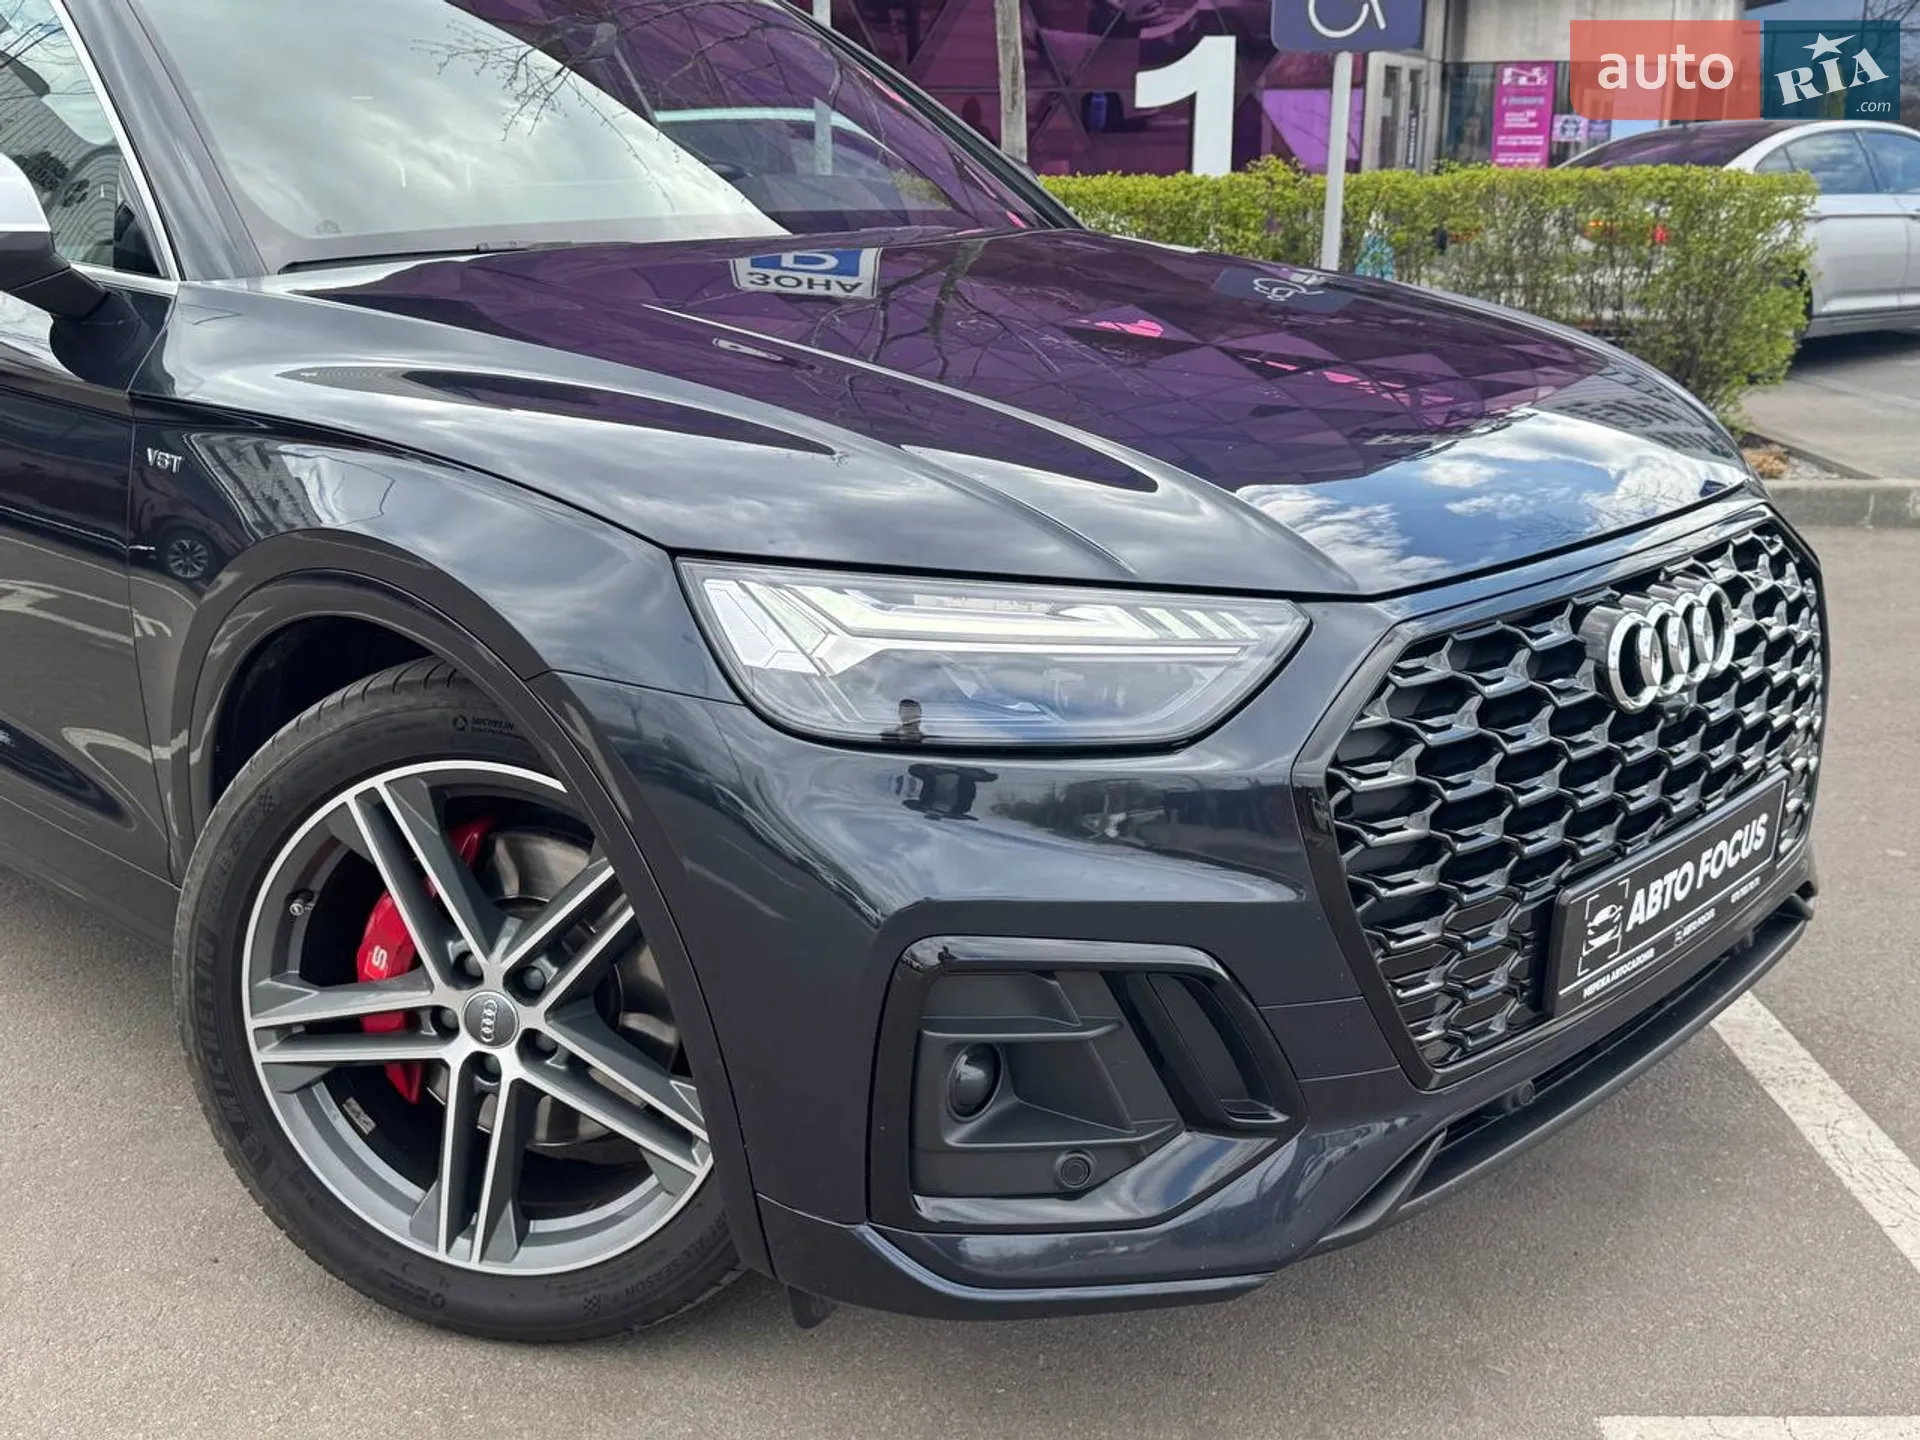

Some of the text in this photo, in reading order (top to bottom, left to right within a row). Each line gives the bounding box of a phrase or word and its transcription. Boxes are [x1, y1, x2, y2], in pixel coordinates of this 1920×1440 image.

[1134, 35, 1236, 176] 1
[1697, 813, 1769, 889] FOCUS
[371, 944, 389, 971] S
